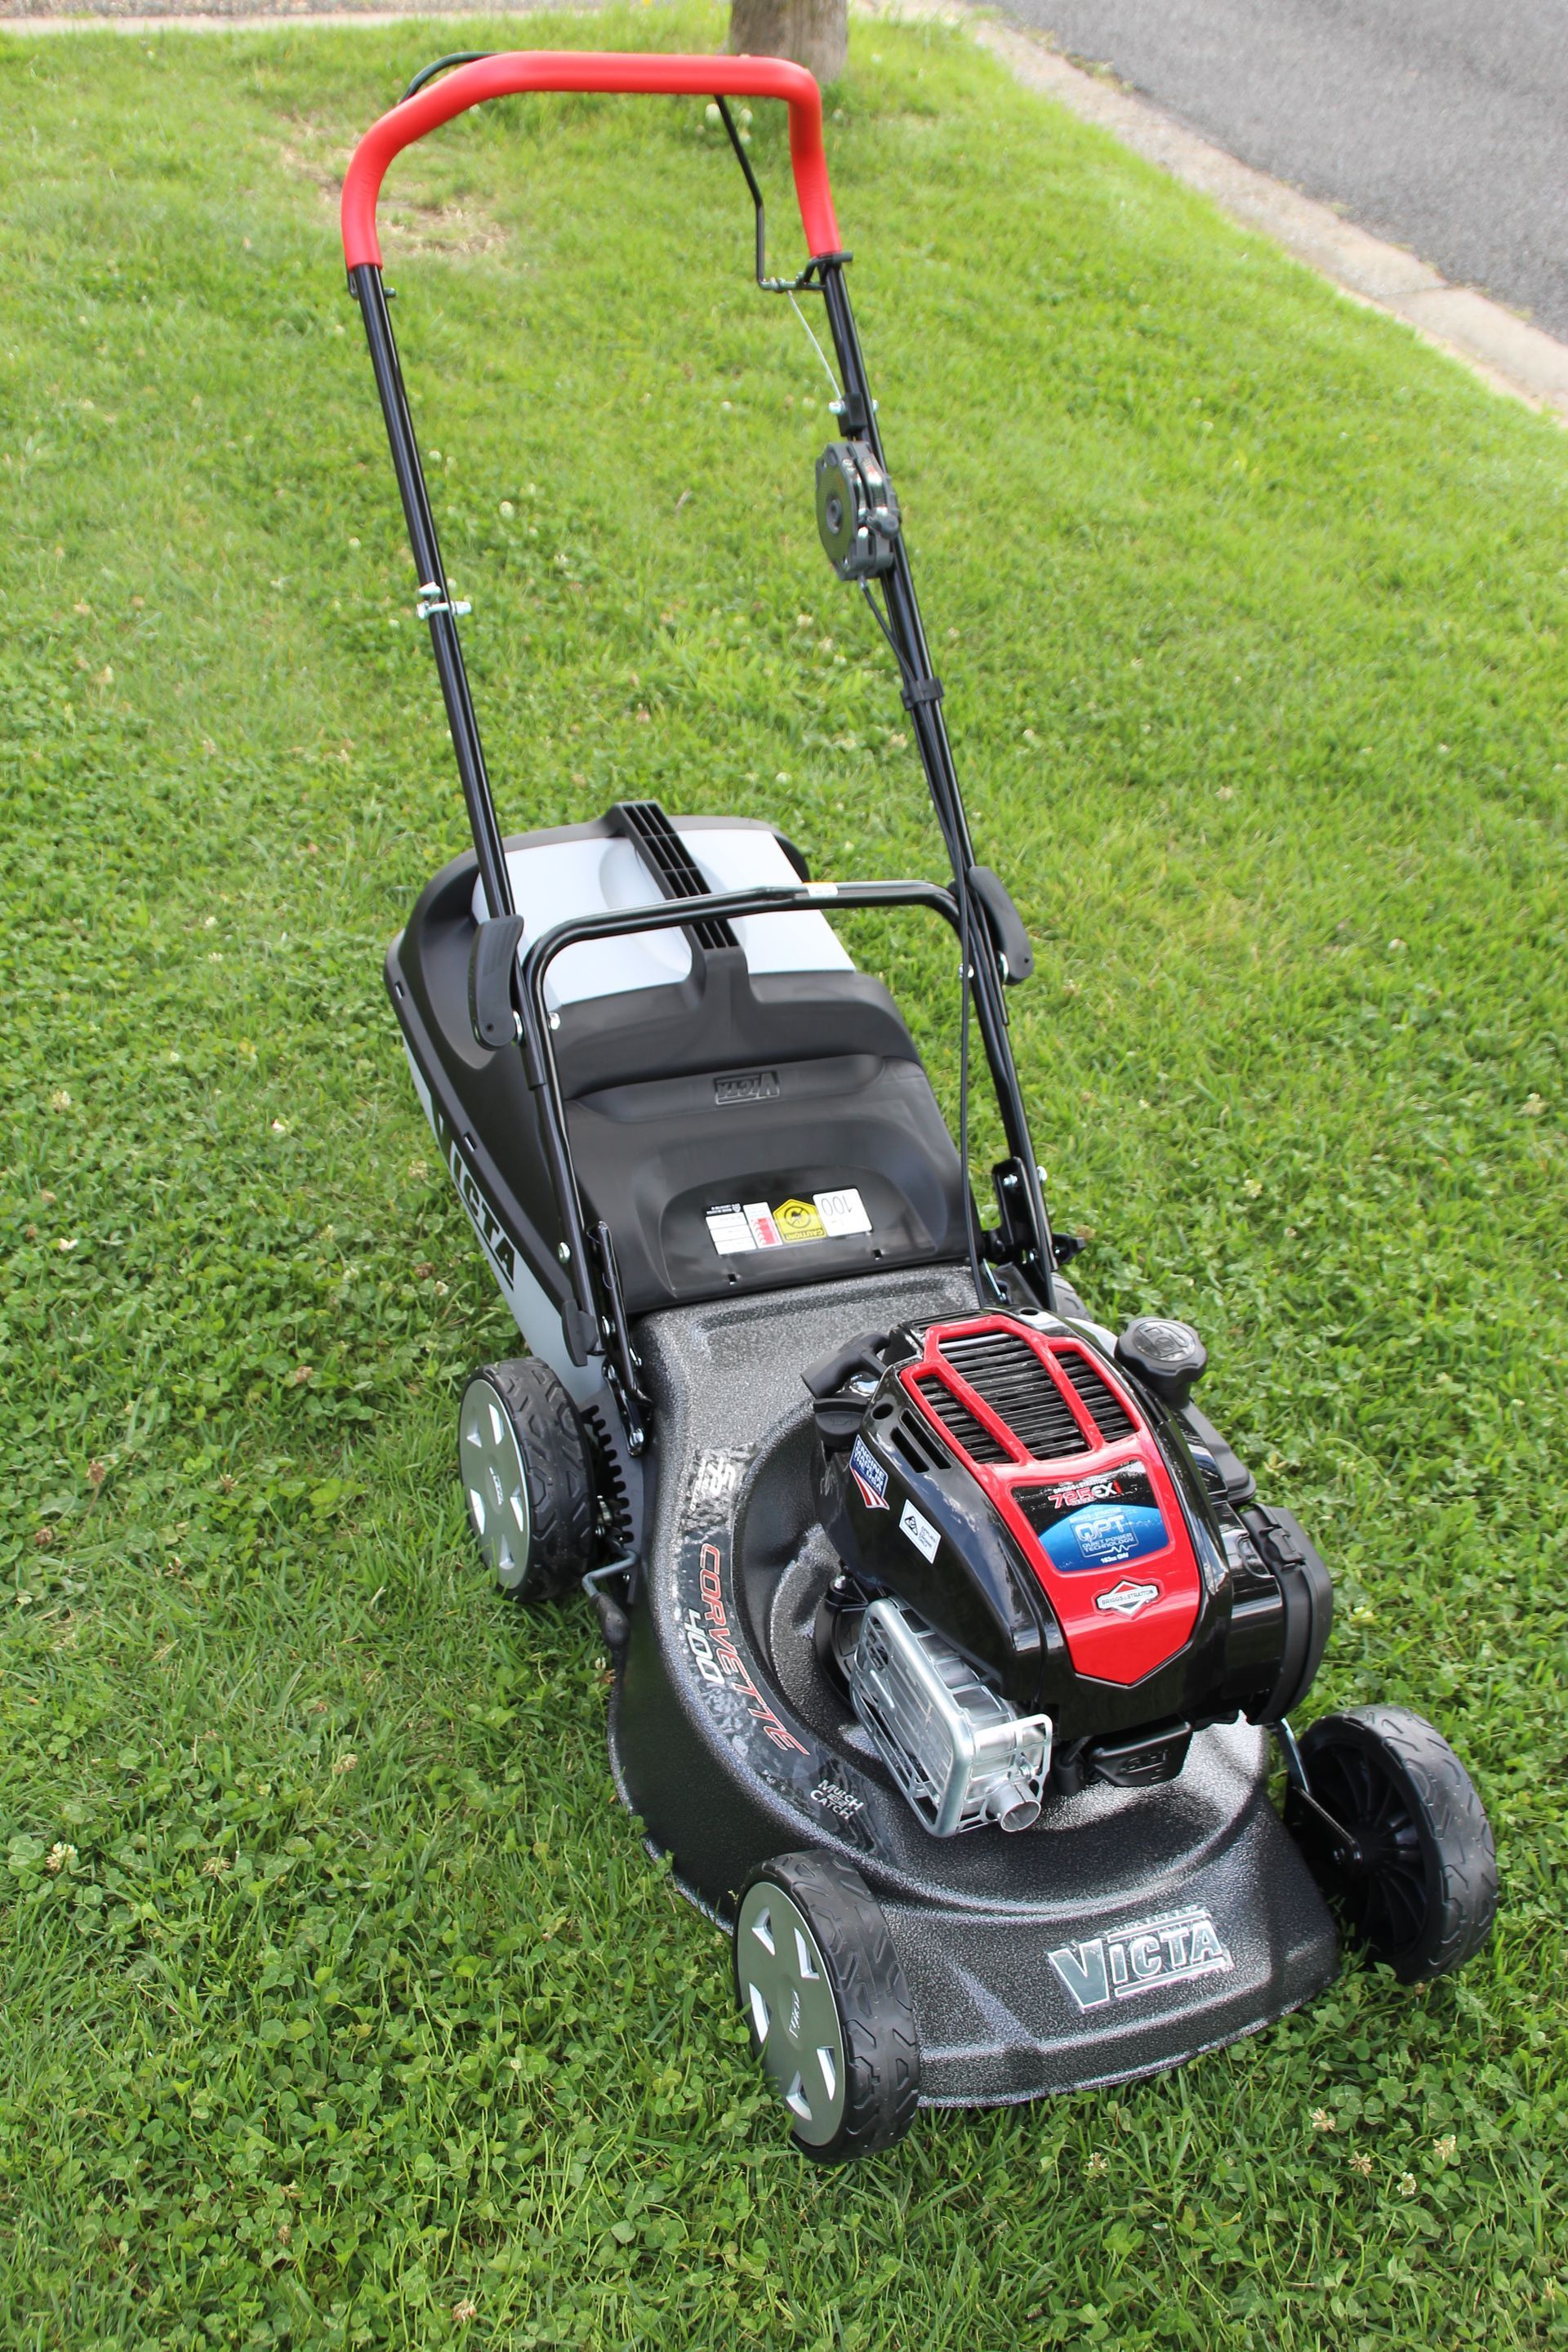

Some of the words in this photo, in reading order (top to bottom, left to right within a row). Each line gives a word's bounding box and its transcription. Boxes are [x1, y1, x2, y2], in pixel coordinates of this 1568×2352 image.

[715, 1071, 779, 1101] VICTA
[820, 1194, 853, 1217] 100
[786, 1228, 824, 1241] CAUTION!
[855, 1446, 875, 1472] MADE
[856, 1439, 886, 1480] ENGINE
[866, 1469, 883, 1494] USA
[1075, 1514, 1125, 1542] QPT
[1081, 1537, 1106, 1549] QUIET
[1105, 1532, 1134, 1544] POWER
[1084, 1537, 1134, 1552] TECHNOLOGY
[684, 1609, 725, 1686] 400
[700, 1543, 811, 1756] CORVETTE
[809, 1789, 855, 1820] CATCH
[817, 1779, 865, 1811] MULCH
[1047, 1919, 1223, 2009] VICTA
